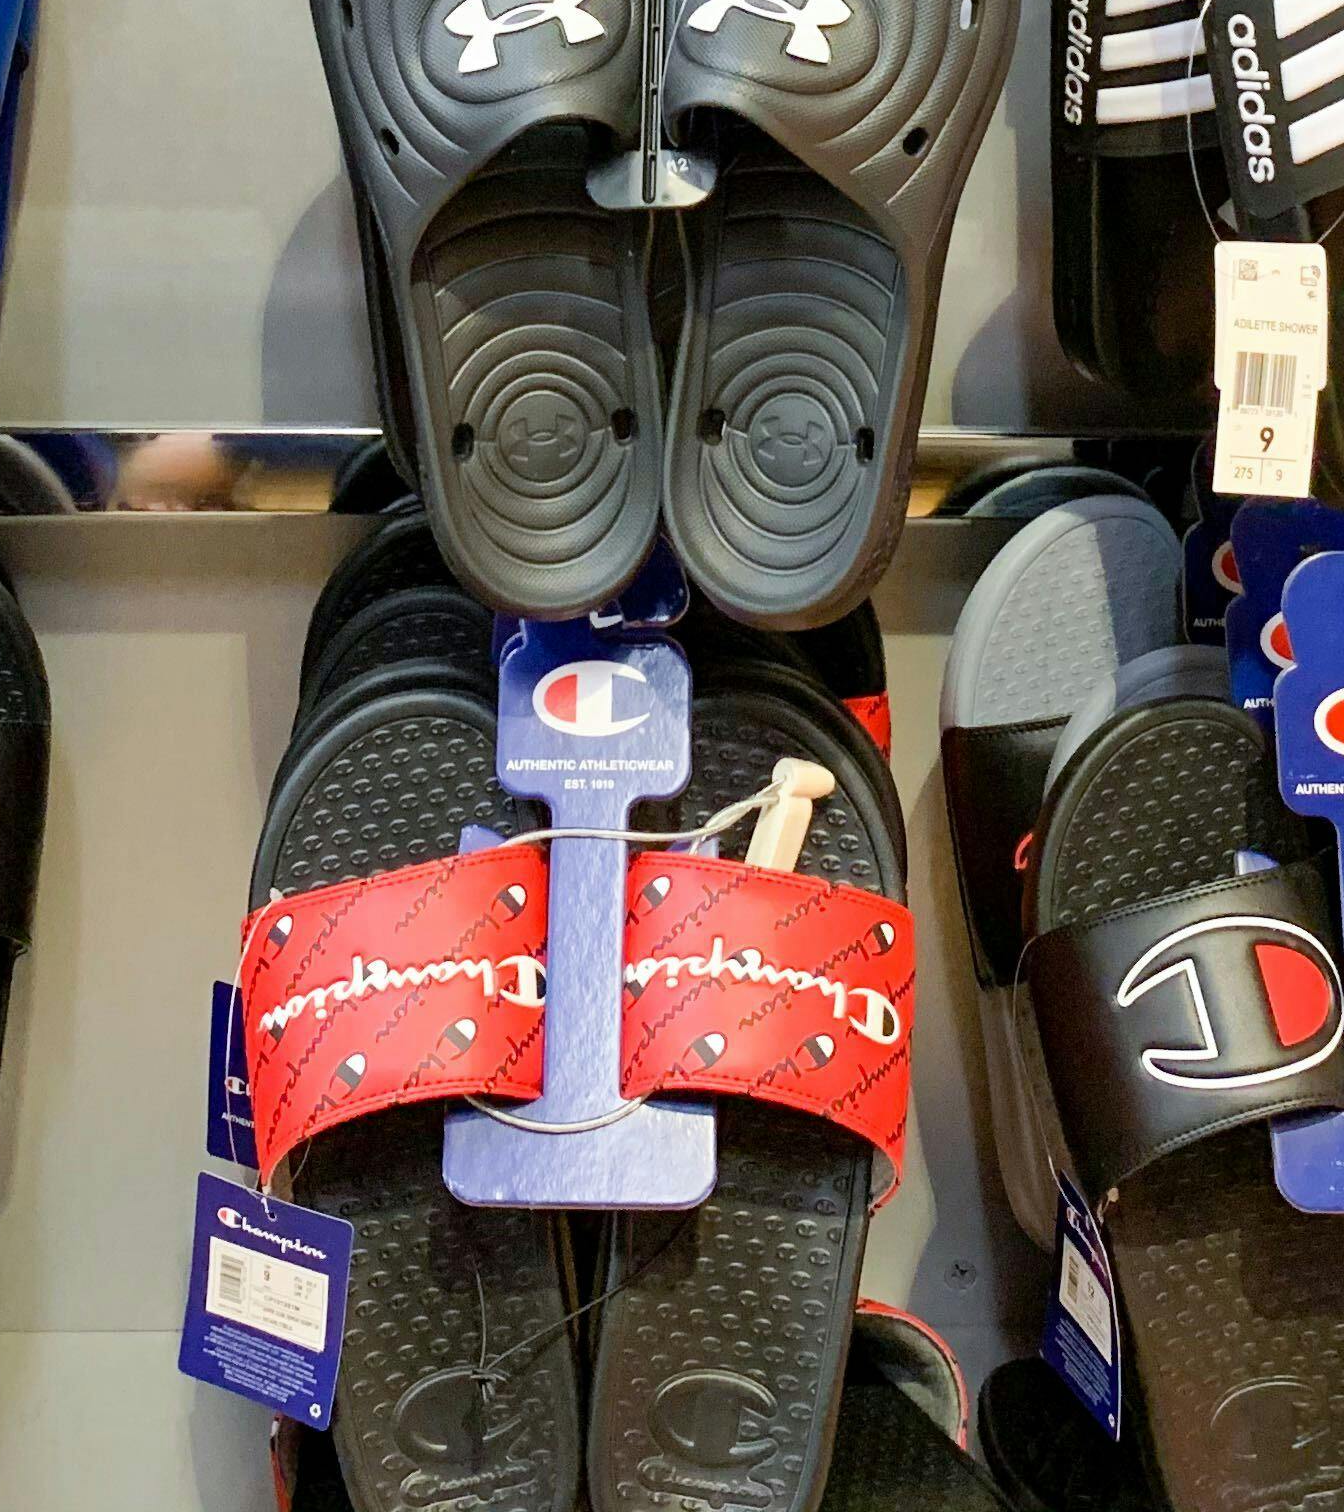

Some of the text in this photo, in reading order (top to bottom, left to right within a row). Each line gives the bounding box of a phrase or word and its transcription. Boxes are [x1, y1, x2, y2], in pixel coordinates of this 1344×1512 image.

[1227, 13, 1277, 185] adidas
[1233, 318, 1319, 336] ADILETTE SHOWER
[1259, 426, 1275, 454] 9
[1233, 465, 1283, 482] 275 9
[506, 759, 675, 771] AUTHENTIC ATHLETICWEAR
[563, 778, 615, 790] EST. 1919
[258, 953, 547, 1033] Champion
[623, 934, 901, 1046] Champion
[217, 1206, 328, 1261] Champion
